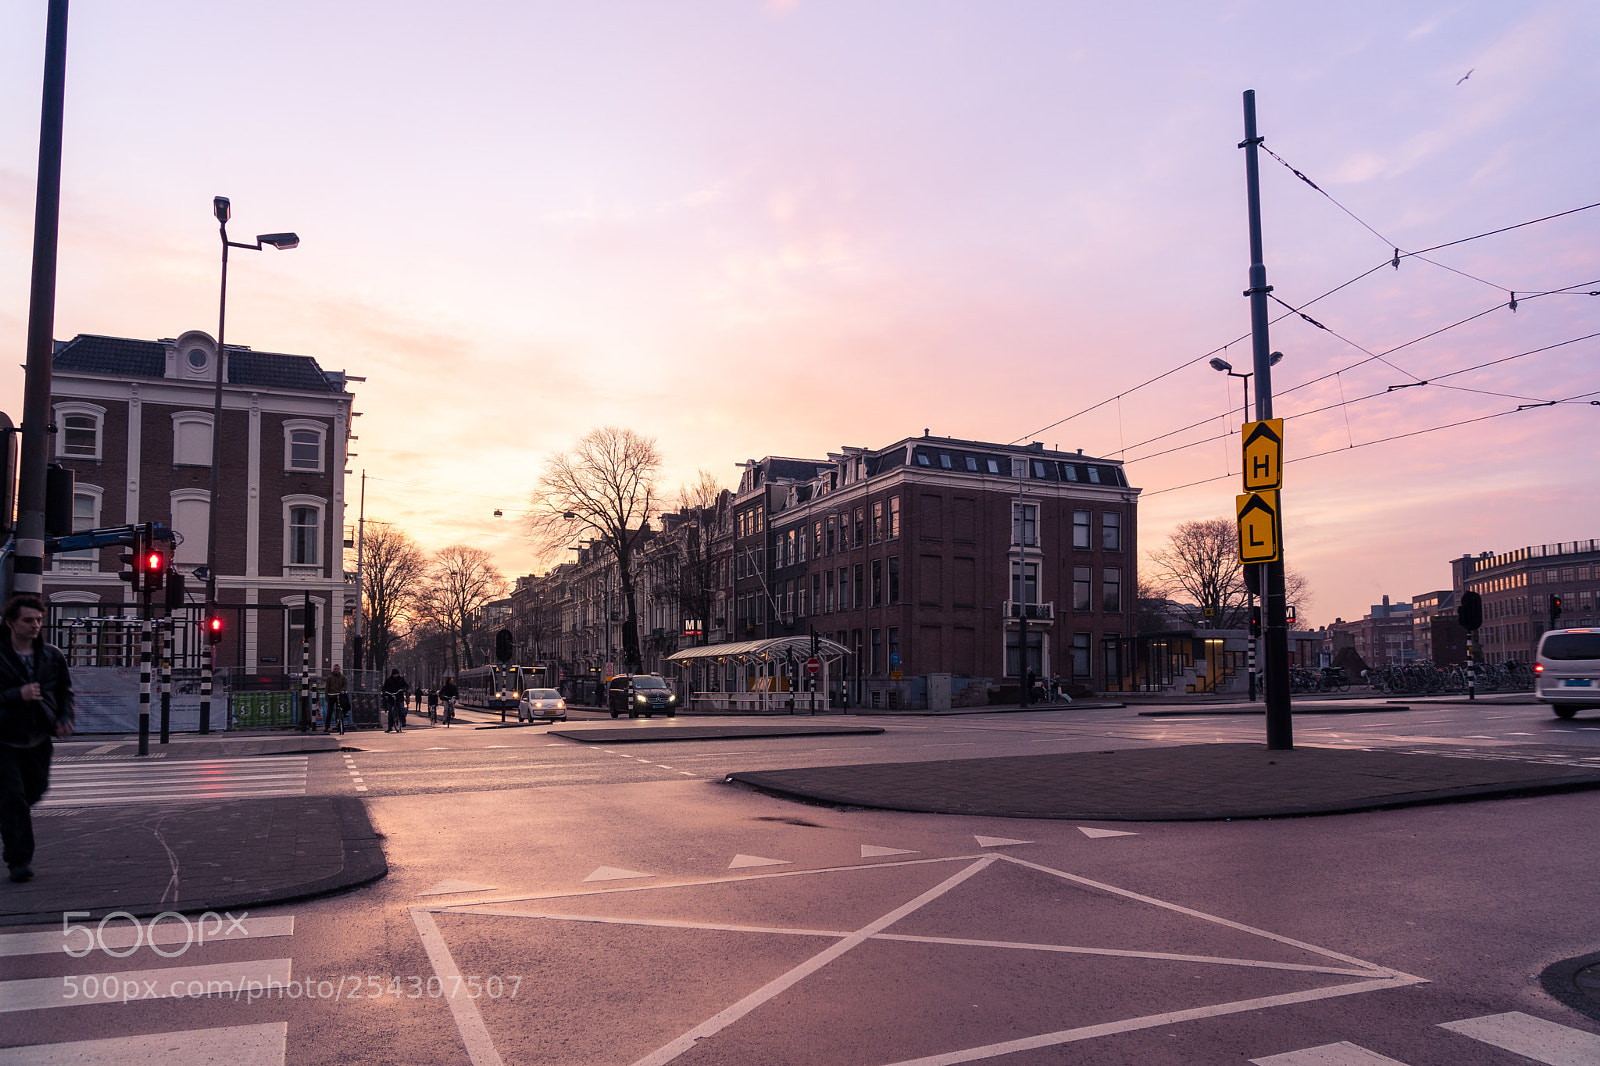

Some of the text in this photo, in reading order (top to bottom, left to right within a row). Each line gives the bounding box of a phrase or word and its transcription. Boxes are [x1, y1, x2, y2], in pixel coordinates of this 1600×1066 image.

[1253, 455, 1270, 478] H
[1249, 524, 1264, 547] L
[685, 620, 694, 630] M
